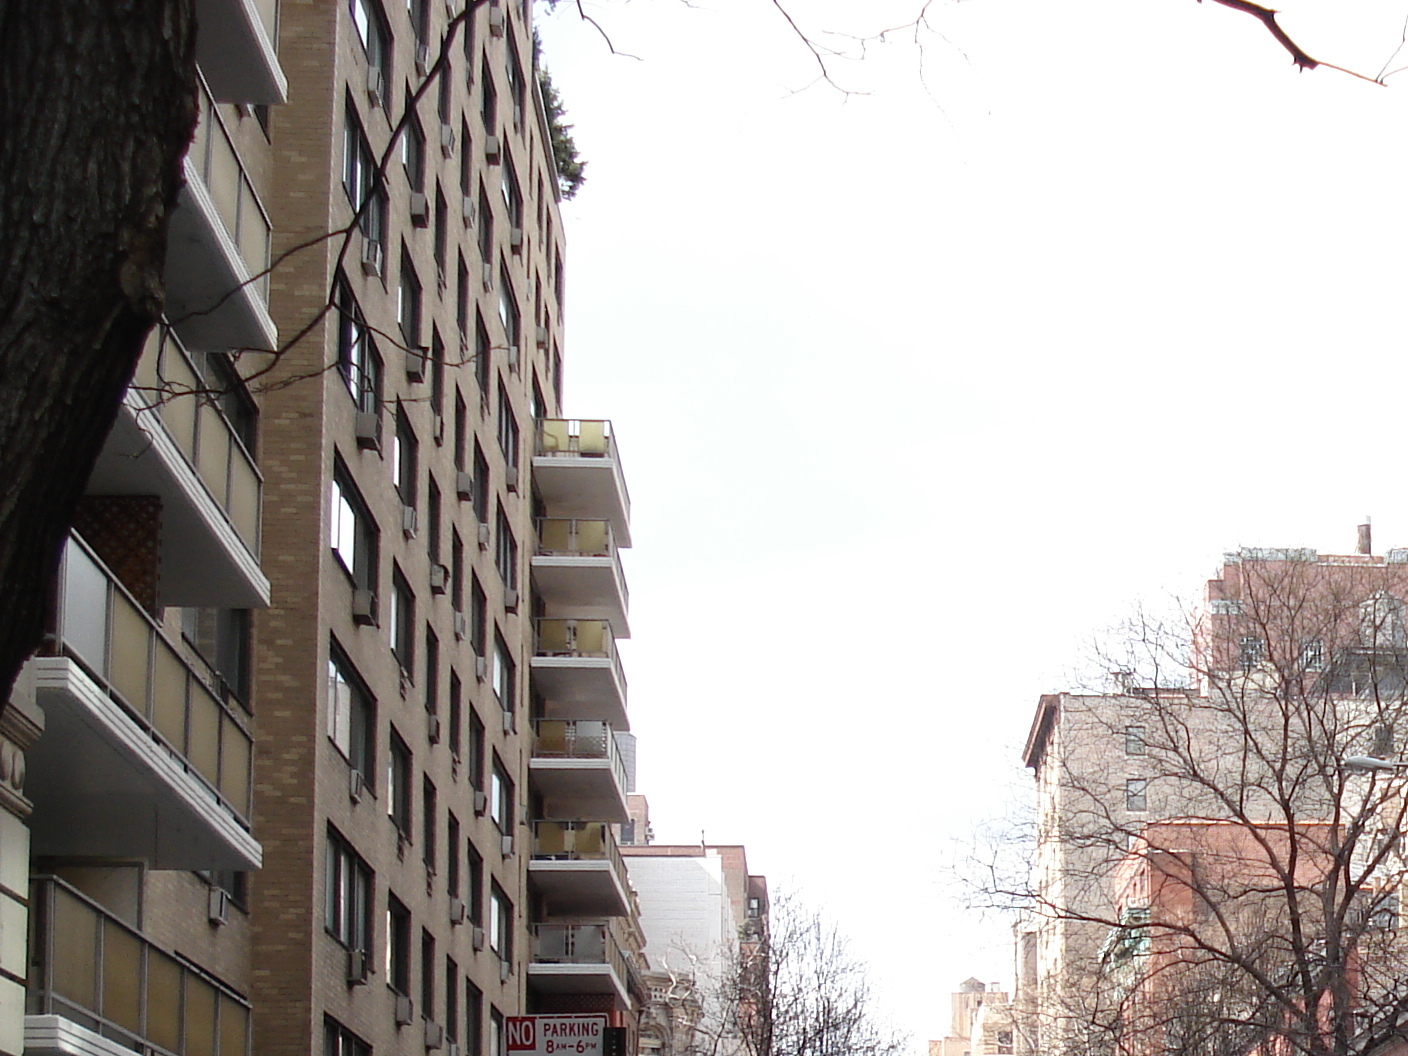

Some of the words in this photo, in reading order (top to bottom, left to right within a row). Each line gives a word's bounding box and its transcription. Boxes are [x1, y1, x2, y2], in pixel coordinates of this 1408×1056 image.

[507, 1021, 534, 1046] NO
[543, 1022, 599, 1037] PARKING
[546, 1040, 597, 1054] 8AM-6PM
